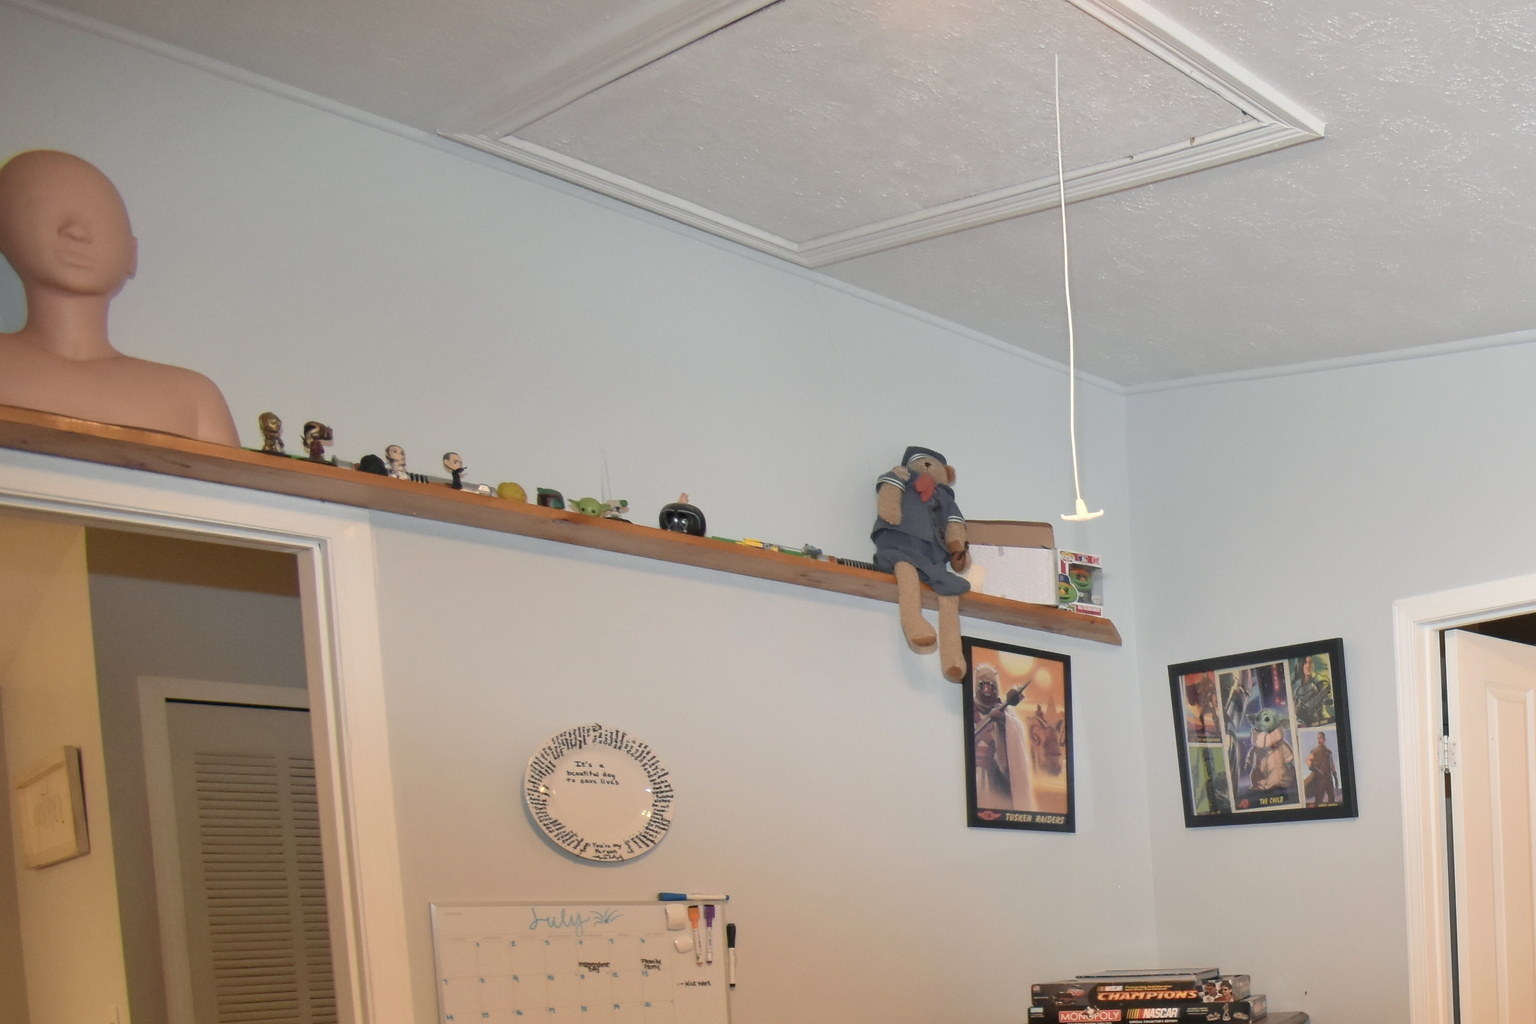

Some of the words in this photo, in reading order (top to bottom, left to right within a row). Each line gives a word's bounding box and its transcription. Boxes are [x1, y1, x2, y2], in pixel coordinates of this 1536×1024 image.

[566, 770, 599, 778] beautiful
[602, 771, 616, 780] day
[600, 778, 619, 786] lives
[1269, 796, 1284, 804] CHILD
[1005, 813, 1032, 822] TUSKEN
[1035, 816, 1065, 824] RAIDERS
[528, 907, 591, 937] July
[1097, 990, 1198, 1001] CHAMPIONS
[1142, 1008, 1179, 1018] NASCAR
